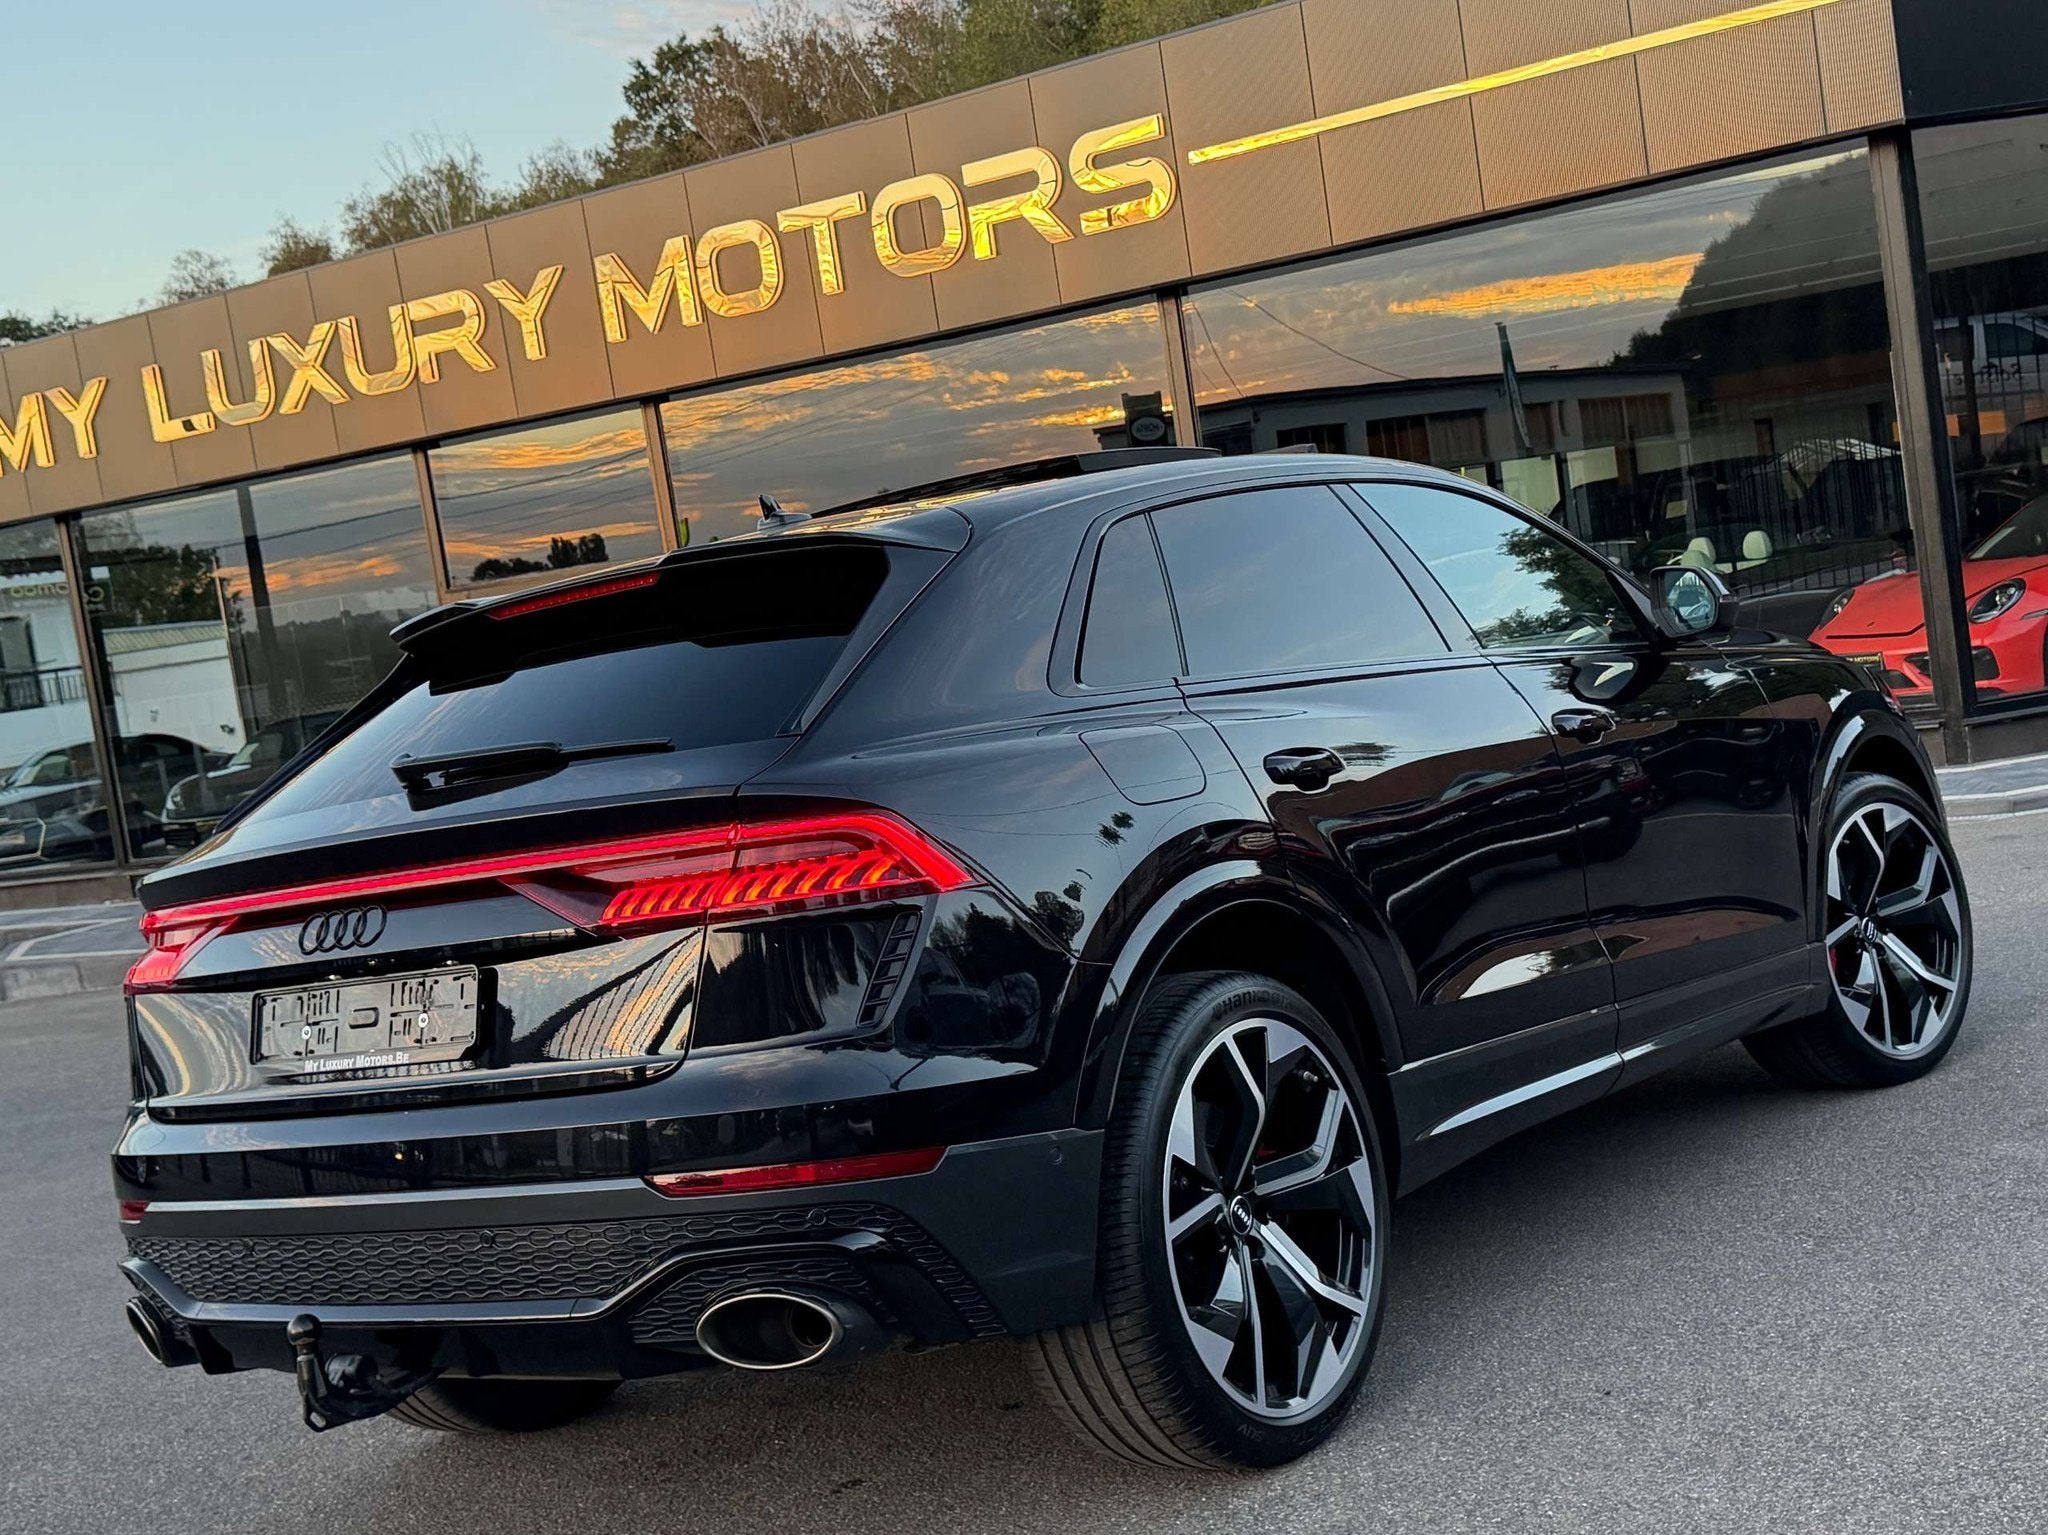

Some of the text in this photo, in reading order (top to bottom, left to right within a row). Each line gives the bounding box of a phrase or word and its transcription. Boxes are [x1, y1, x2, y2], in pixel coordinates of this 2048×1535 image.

[0, 113, 1178, 478] MY LUXURY MOTORS
